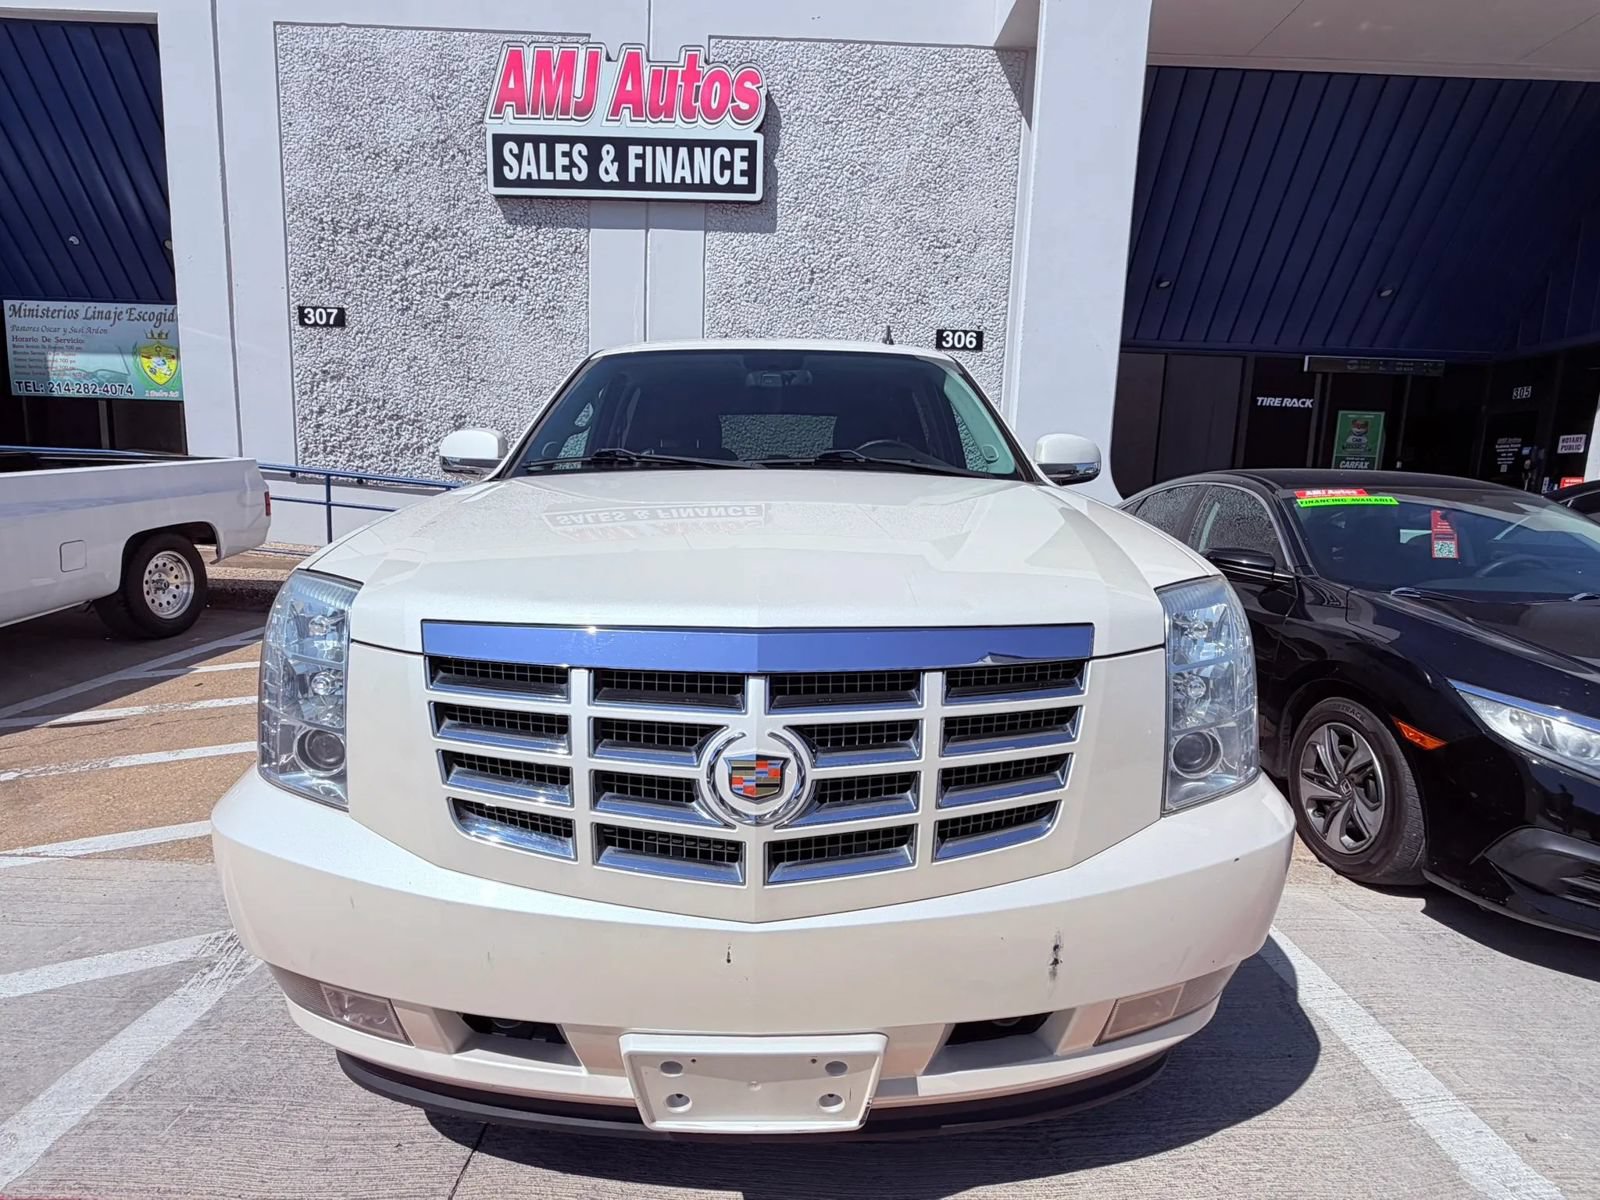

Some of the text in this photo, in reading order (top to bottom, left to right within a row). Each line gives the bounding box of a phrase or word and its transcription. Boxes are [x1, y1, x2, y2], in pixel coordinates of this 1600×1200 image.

[490, 44, 764, 125] AMJ Autos
[503, 141, 749, 186] SALES & FINANCE
[9, 302, 79, 320] Ministerios
[82, 305, 123, 327] Linaje
[303, 308, 338, 325] 307
[12, 335, 38, 343] Horario
[41, 335, 51, 343] De
[942, 331, 977, 348] 306
[16, 381, 44, 393] TEL:
[49, 382, 134, 395] 214-282-4074
[1256, 397, 1314, 408] TIRE RACK
[1561, 436, 1583, 444] NOTARY
[1560, 443, 1582, 452] PUBLIC
[1340, 460, 1370, 469] CARFAX
